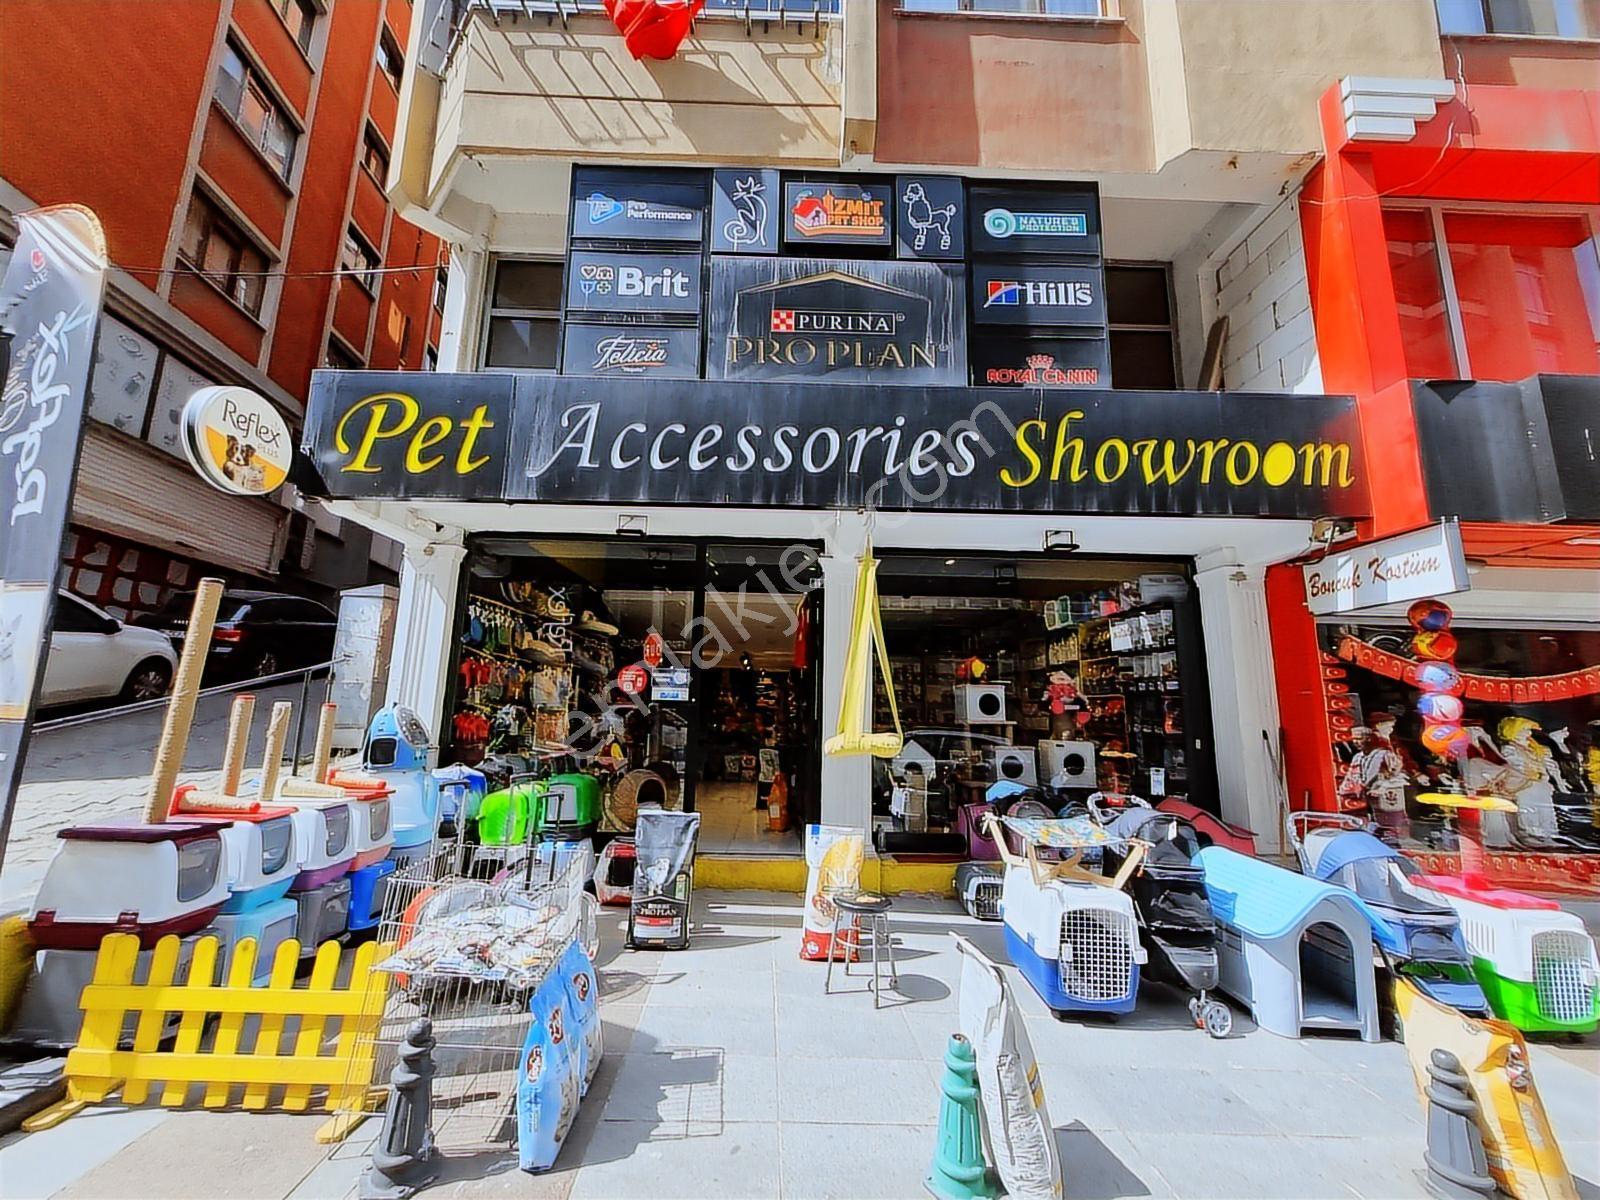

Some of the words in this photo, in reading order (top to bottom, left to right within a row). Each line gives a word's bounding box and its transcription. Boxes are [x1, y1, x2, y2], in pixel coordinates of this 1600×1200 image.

[626, 199, 648, 211] Pro
[626, 208, 693, 221] Performance
[851, 215, 884, 227] SHOP
[617, 266, 690, 298] Brit
[1025, 280, 1094, 307] Hill's
[798, 315, 890, 332] PURINA
[592, 333, 668, 369] Felicia
[728, 336, 817, 366] PRO
[827, 340, 937, 369] PLAN
[987, 369, 1039, 384] ROYAL
[1043, 370, 1098, 385] CANIN
[222, 399, 280, 449] Reflex
[334, 391, 495, 475] Pet
[524, 400, 980, 479] Accessories
[999, 410, 1355, 488] Showroom
[1309, 564, 1363, 598] Boncuk
[1367, 552, 1440, 585] Kostüm
